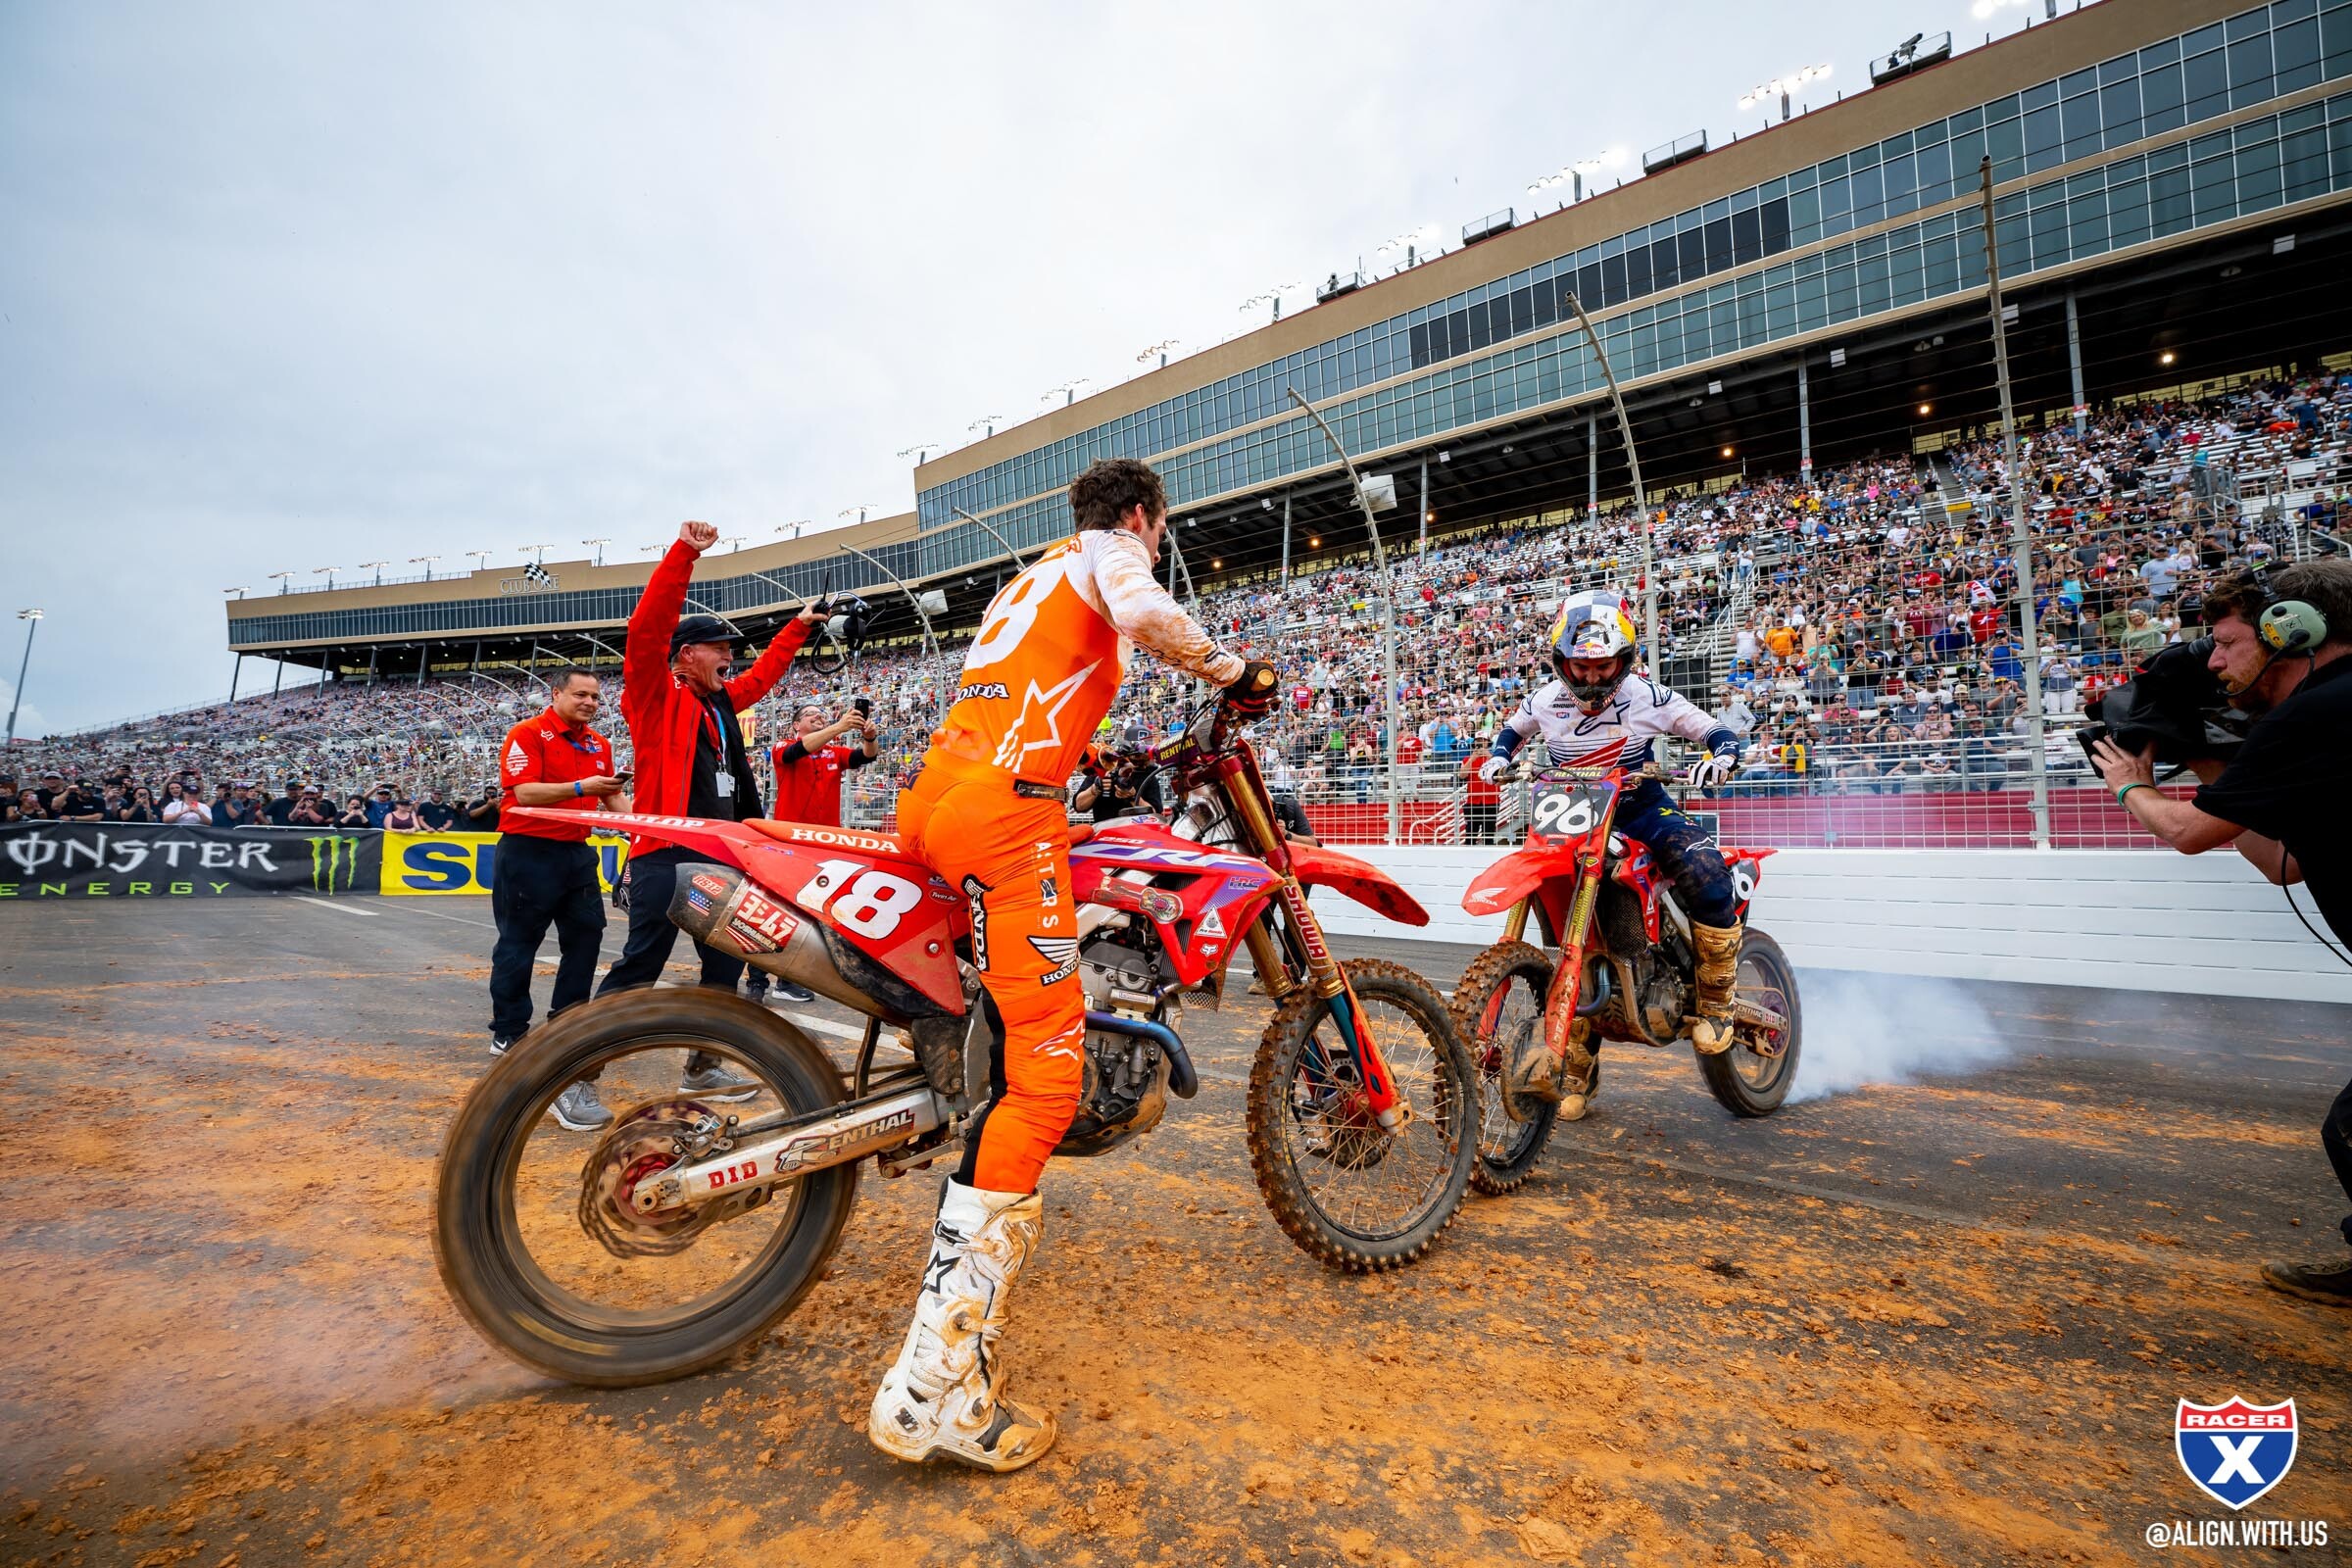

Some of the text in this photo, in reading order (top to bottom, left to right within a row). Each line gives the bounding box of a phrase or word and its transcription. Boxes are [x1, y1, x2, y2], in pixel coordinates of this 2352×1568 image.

[501, 578, 529, 594] CLUB
[963, 552, 1065, 671] 8
[956, 683, 1009, 702] ONDA
[1534, 793, 1601, 835] 96
[791, 828, 901, 854] HONDA
[0, 882, 230, 896] ENERGY
[1732, 866, 1755, 900] 6
[796, 858, 923, 940] 18
[737, 894, 798, 941] ヨシムラ
[1283, 885, 1328, 959] SHOWA
[1043, 960, 1079, 985] HOND
[708, 1161, 758, 1190] D.I.D
